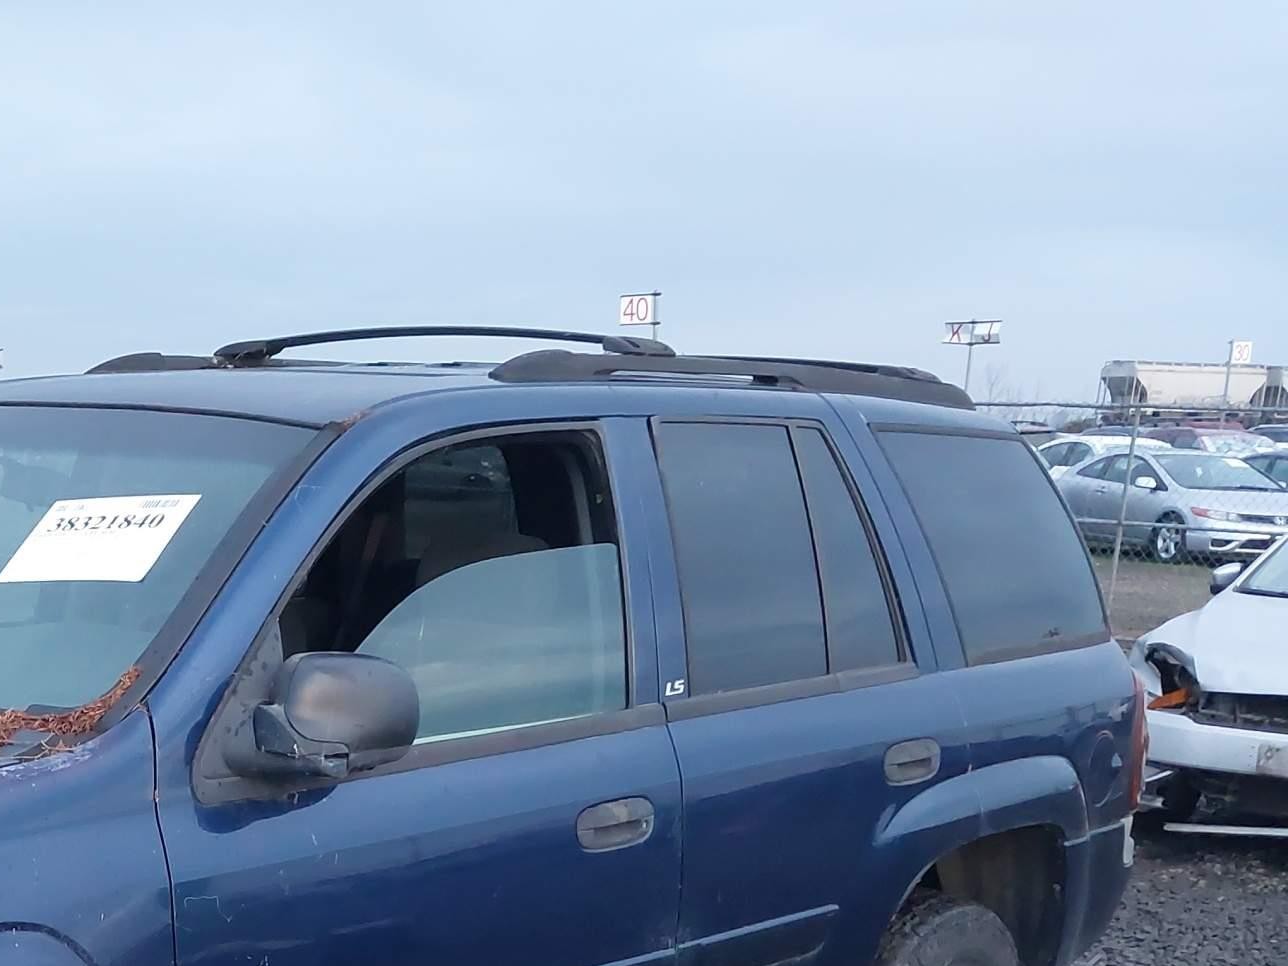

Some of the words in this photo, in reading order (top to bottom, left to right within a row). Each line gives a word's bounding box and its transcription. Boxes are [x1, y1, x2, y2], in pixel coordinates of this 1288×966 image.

[623, 297, 649, 321] 40
[46, 513, 166, 533] 38321840
[664, 679, 685, 697] LS
